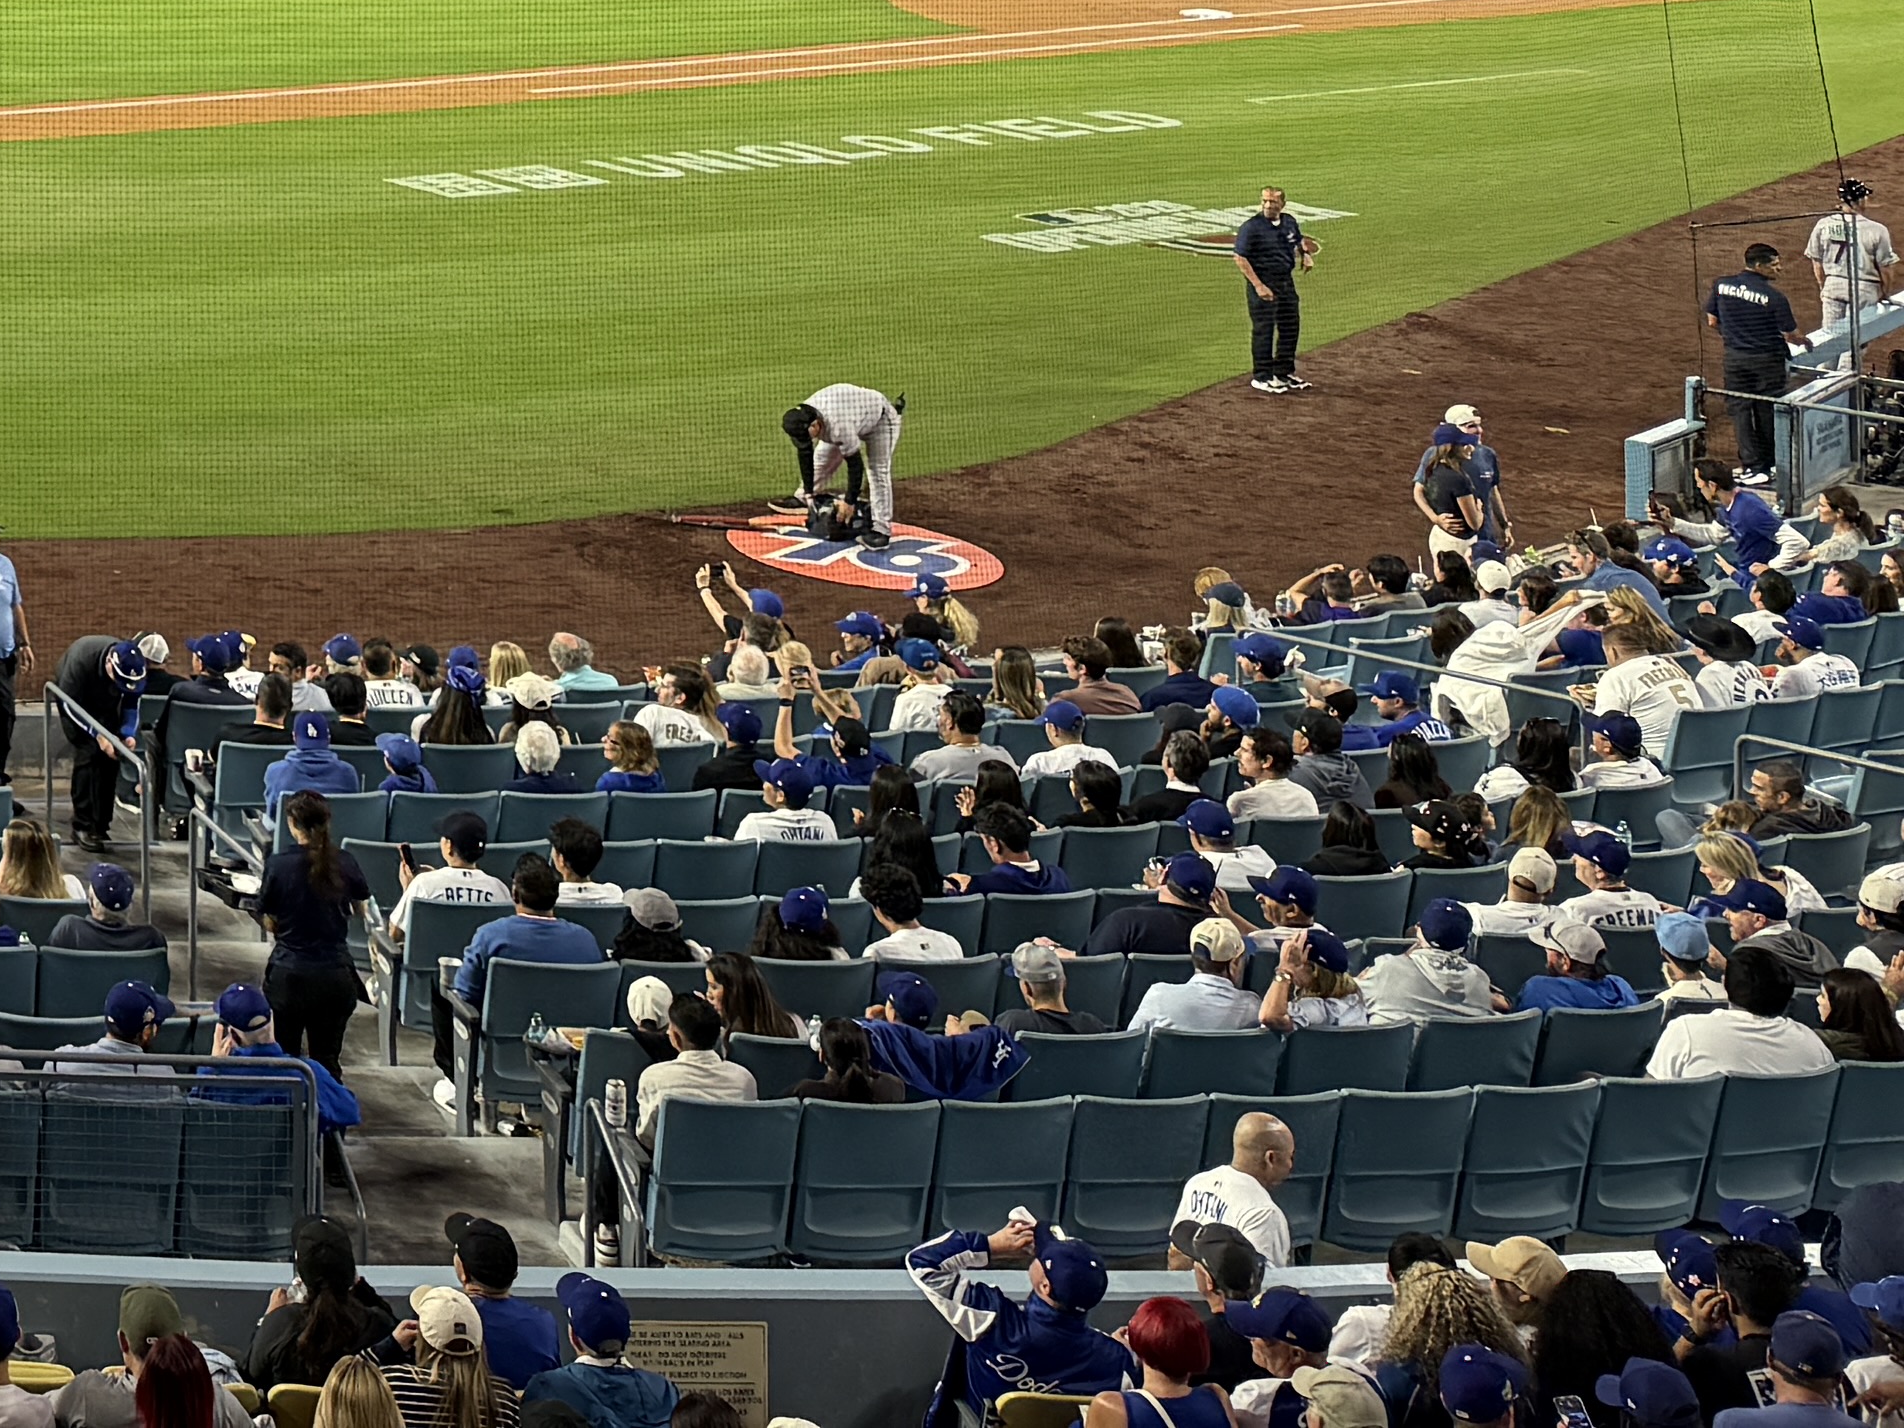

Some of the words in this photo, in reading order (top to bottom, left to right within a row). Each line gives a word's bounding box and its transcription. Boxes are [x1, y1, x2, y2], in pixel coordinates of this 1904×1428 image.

[580, 135, 934, 178] UNIQLO
[907, 110, 1184, 146] FIELD
[1668, 684, 1695, 710] 5
